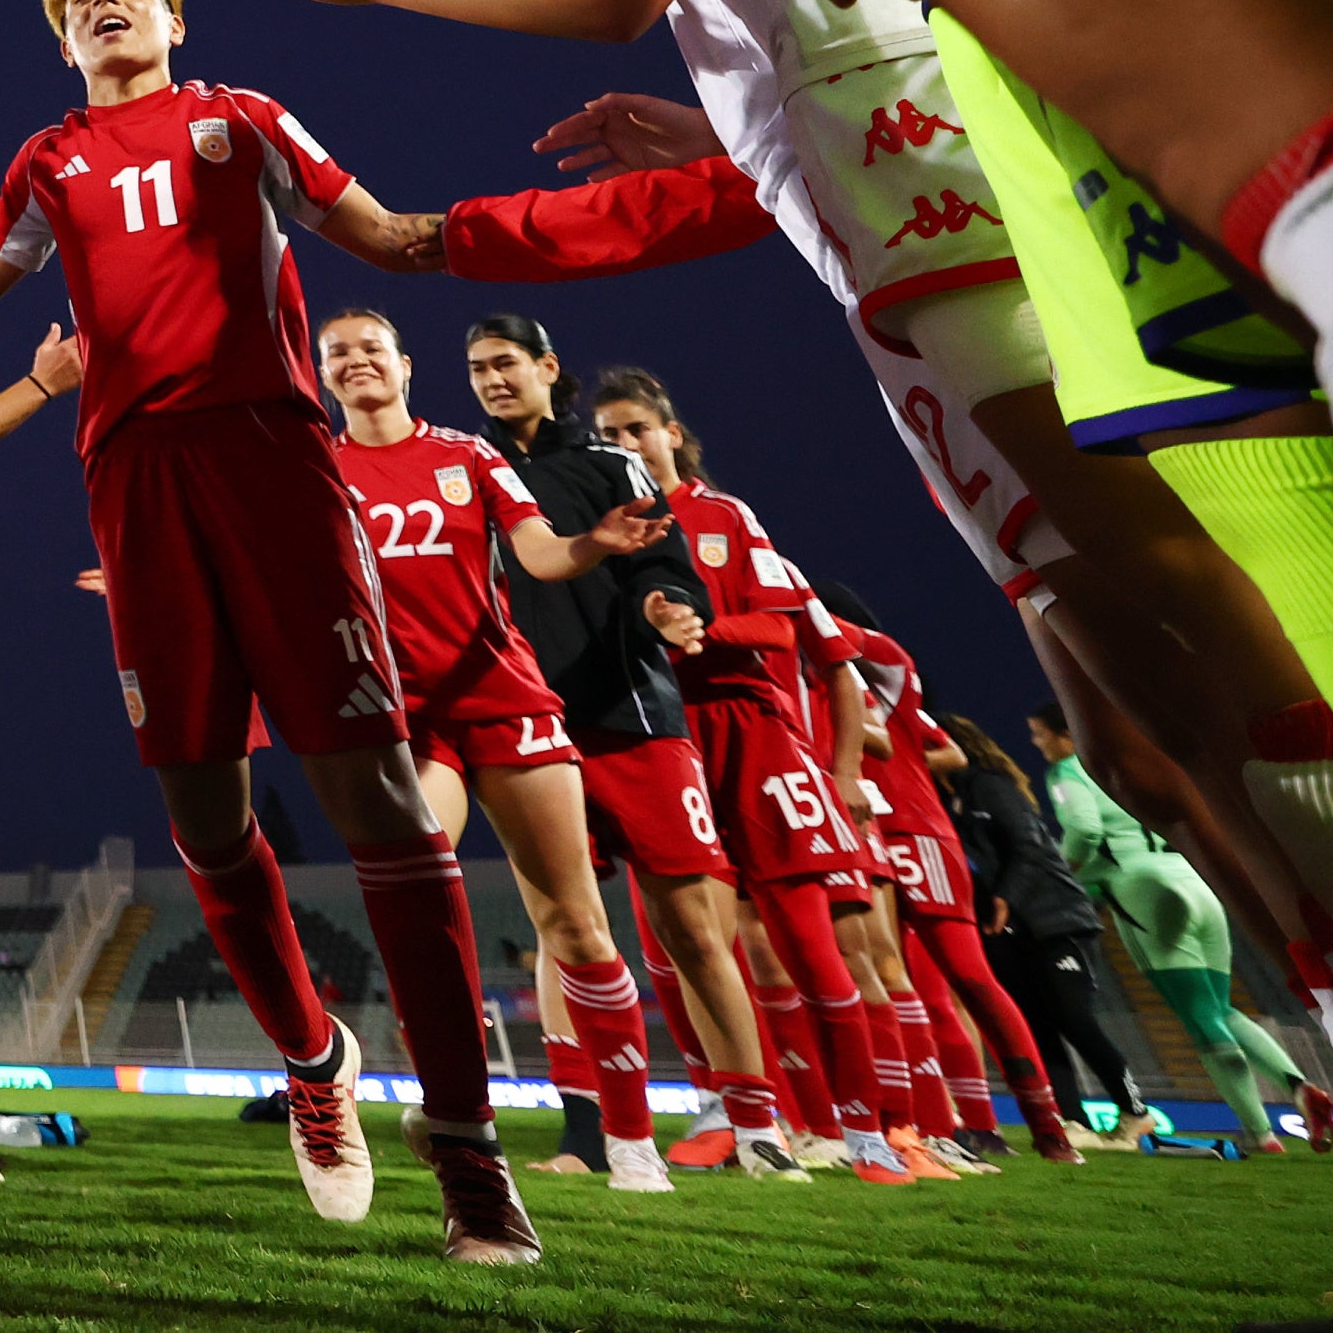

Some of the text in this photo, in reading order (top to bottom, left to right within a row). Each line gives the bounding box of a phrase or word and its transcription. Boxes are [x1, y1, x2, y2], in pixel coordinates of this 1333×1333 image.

[110, 159, 178, 233] 11
[368, 499, 454, 559] 22
[333, 618, 374, 663] 11
[682, 785, 718, 845] 8
[762, 771, 826, 830] 15
